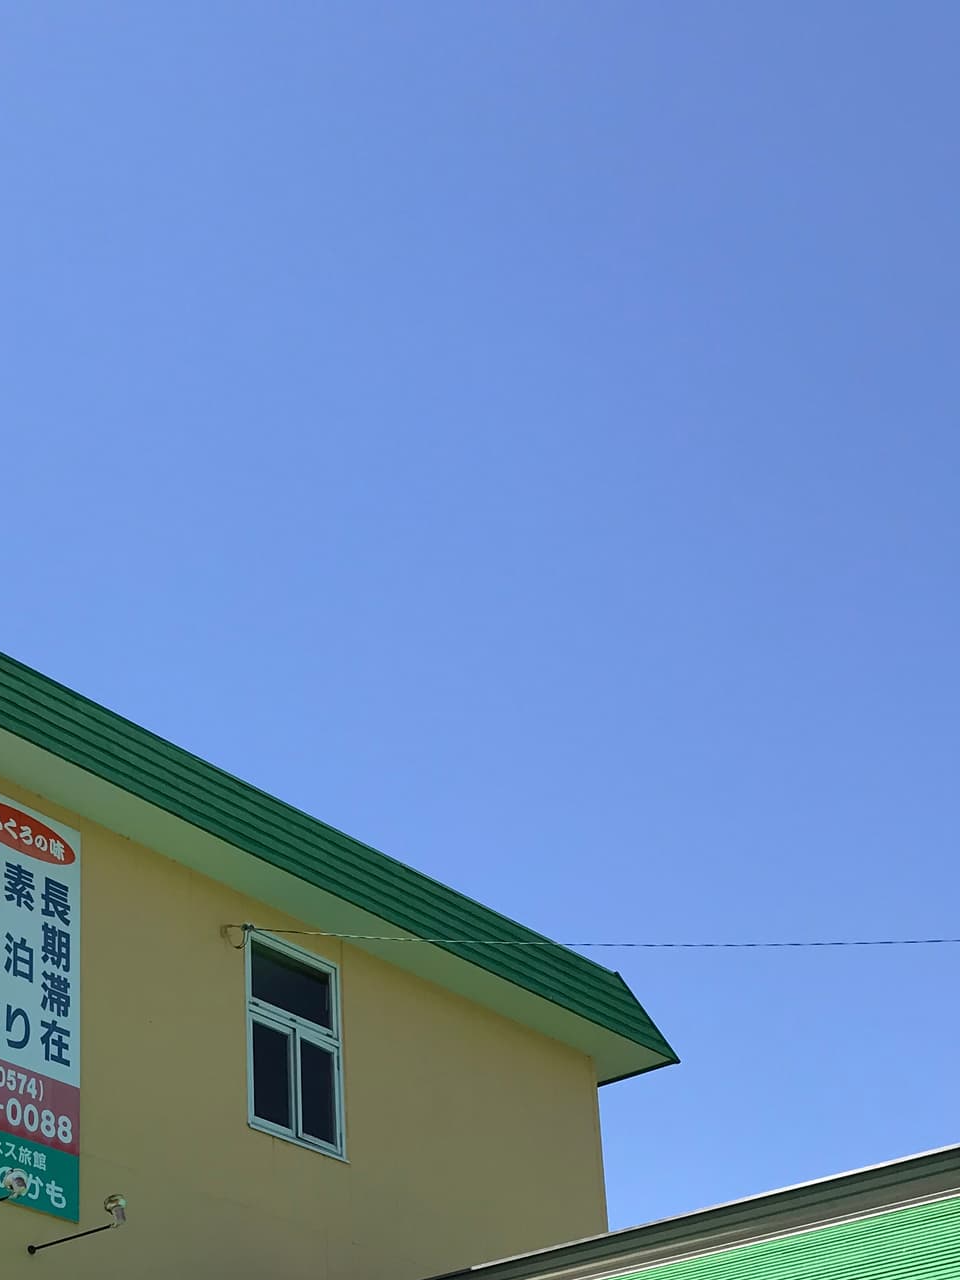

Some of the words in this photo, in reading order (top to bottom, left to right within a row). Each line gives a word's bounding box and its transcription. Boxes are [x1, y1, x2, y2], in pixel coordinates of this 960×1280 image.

[3, 860, 34, 1050] 素泊り
[40, 876, 71, 1067] 長期滞在
